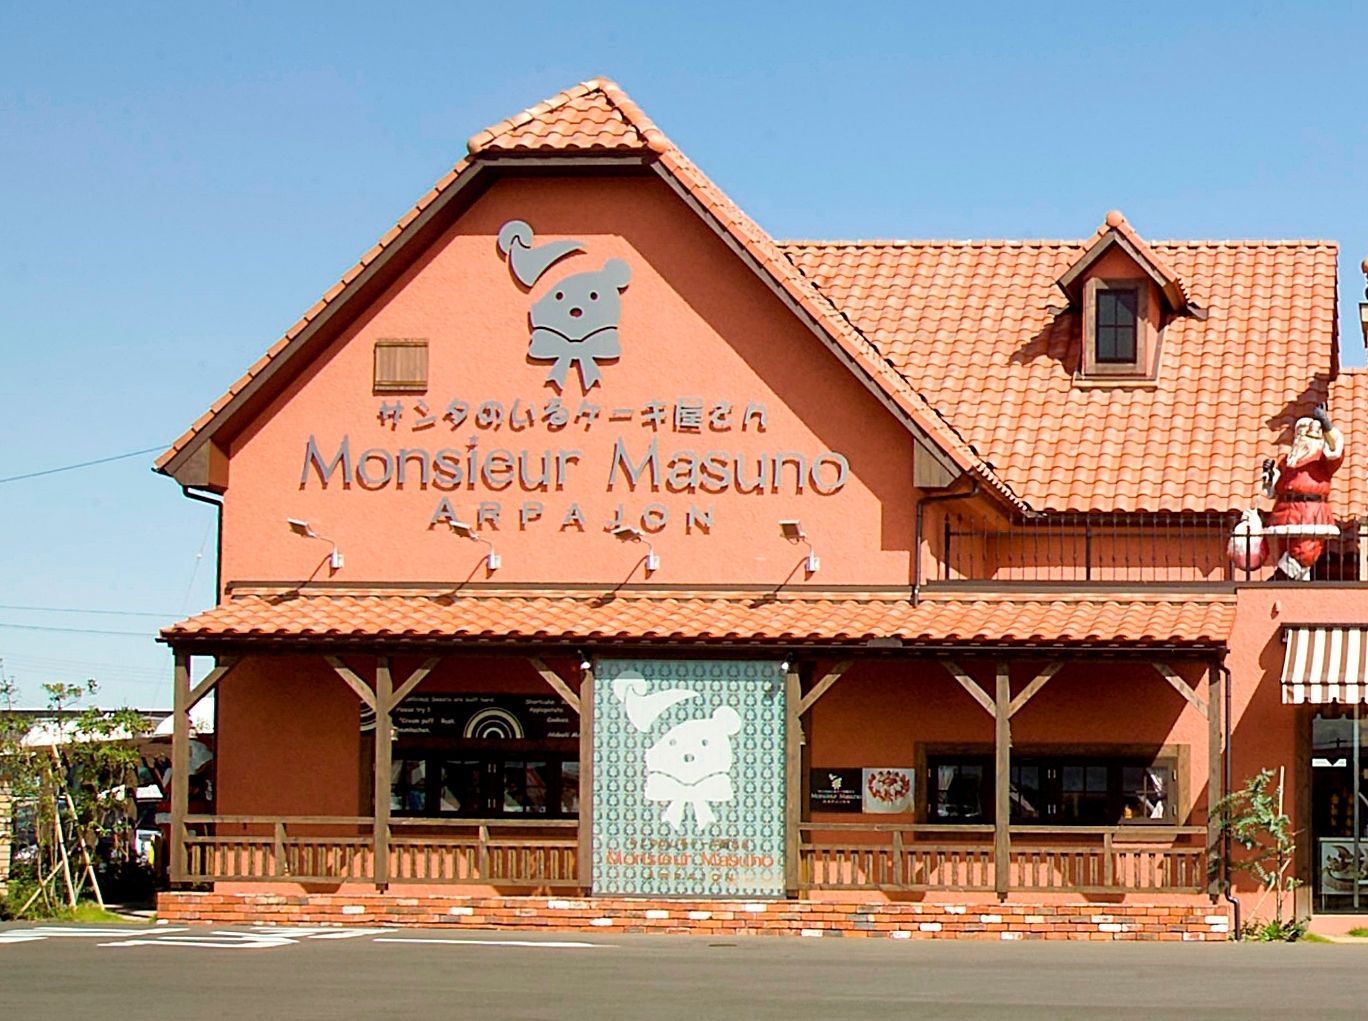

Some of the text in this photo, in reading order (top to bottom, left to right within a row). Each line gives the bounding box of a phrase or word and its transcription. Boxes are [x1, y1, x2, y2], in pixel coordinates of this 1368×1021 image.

[376, 399, 769, 432] サンタのいるケーキ屋さん
[300, 434, 851, 494] Monsieur Masuno
[427, 496, 714, 533] ARPAJON
[606, 849, 774, 867] Monsieur Masuno
